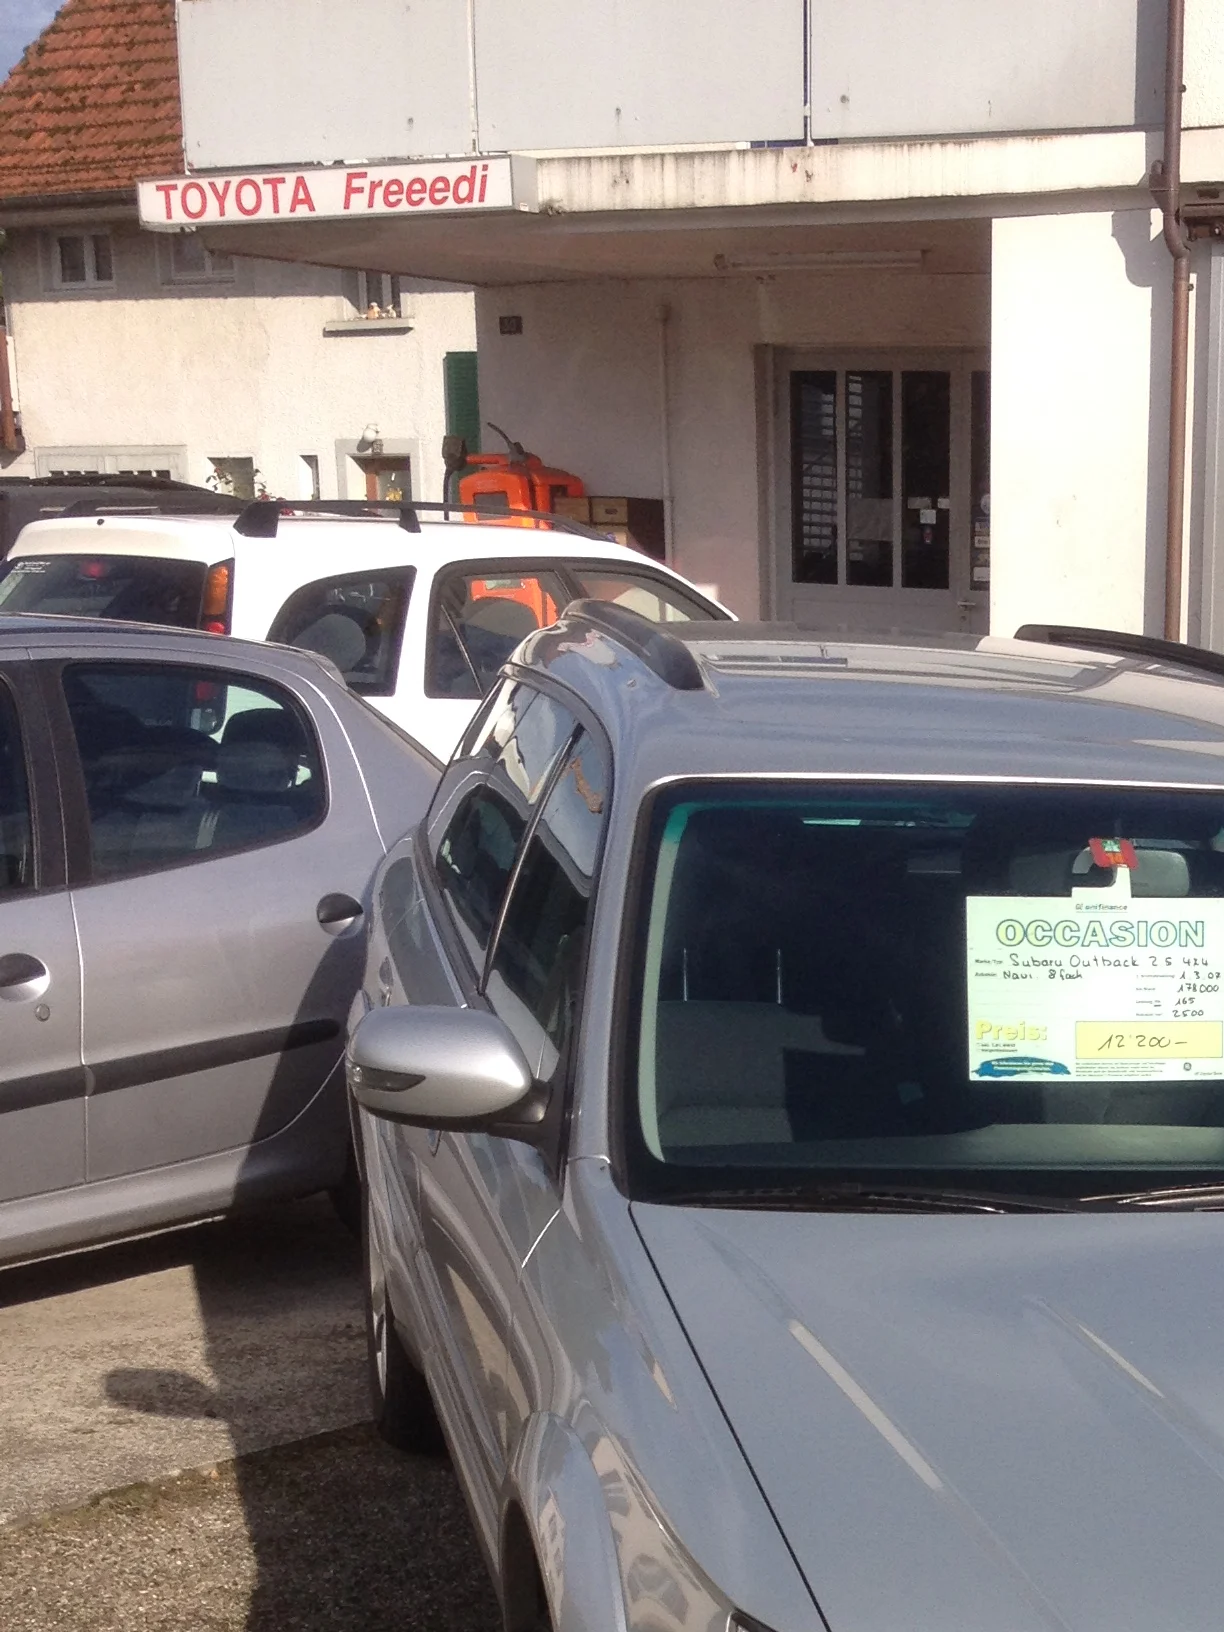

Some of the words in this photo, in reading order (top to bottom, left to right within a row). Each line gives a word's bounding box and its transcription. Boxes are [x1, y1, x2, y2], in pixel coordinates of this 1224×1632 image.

[155, 175, 316, 221] TOYOTA
[343, 164, 489, 210] Freeedi
[996, 918, 1205, 948] OCCASION
[1009, 953, 1063, 967] Subaru
[1069, 954, 1139, 968] Outback
[1175, 997, 1196, 1006] 165
[1172, 1009, 1204, 1018] 2500
[975, 1020, 1048, 1041] Preis:
